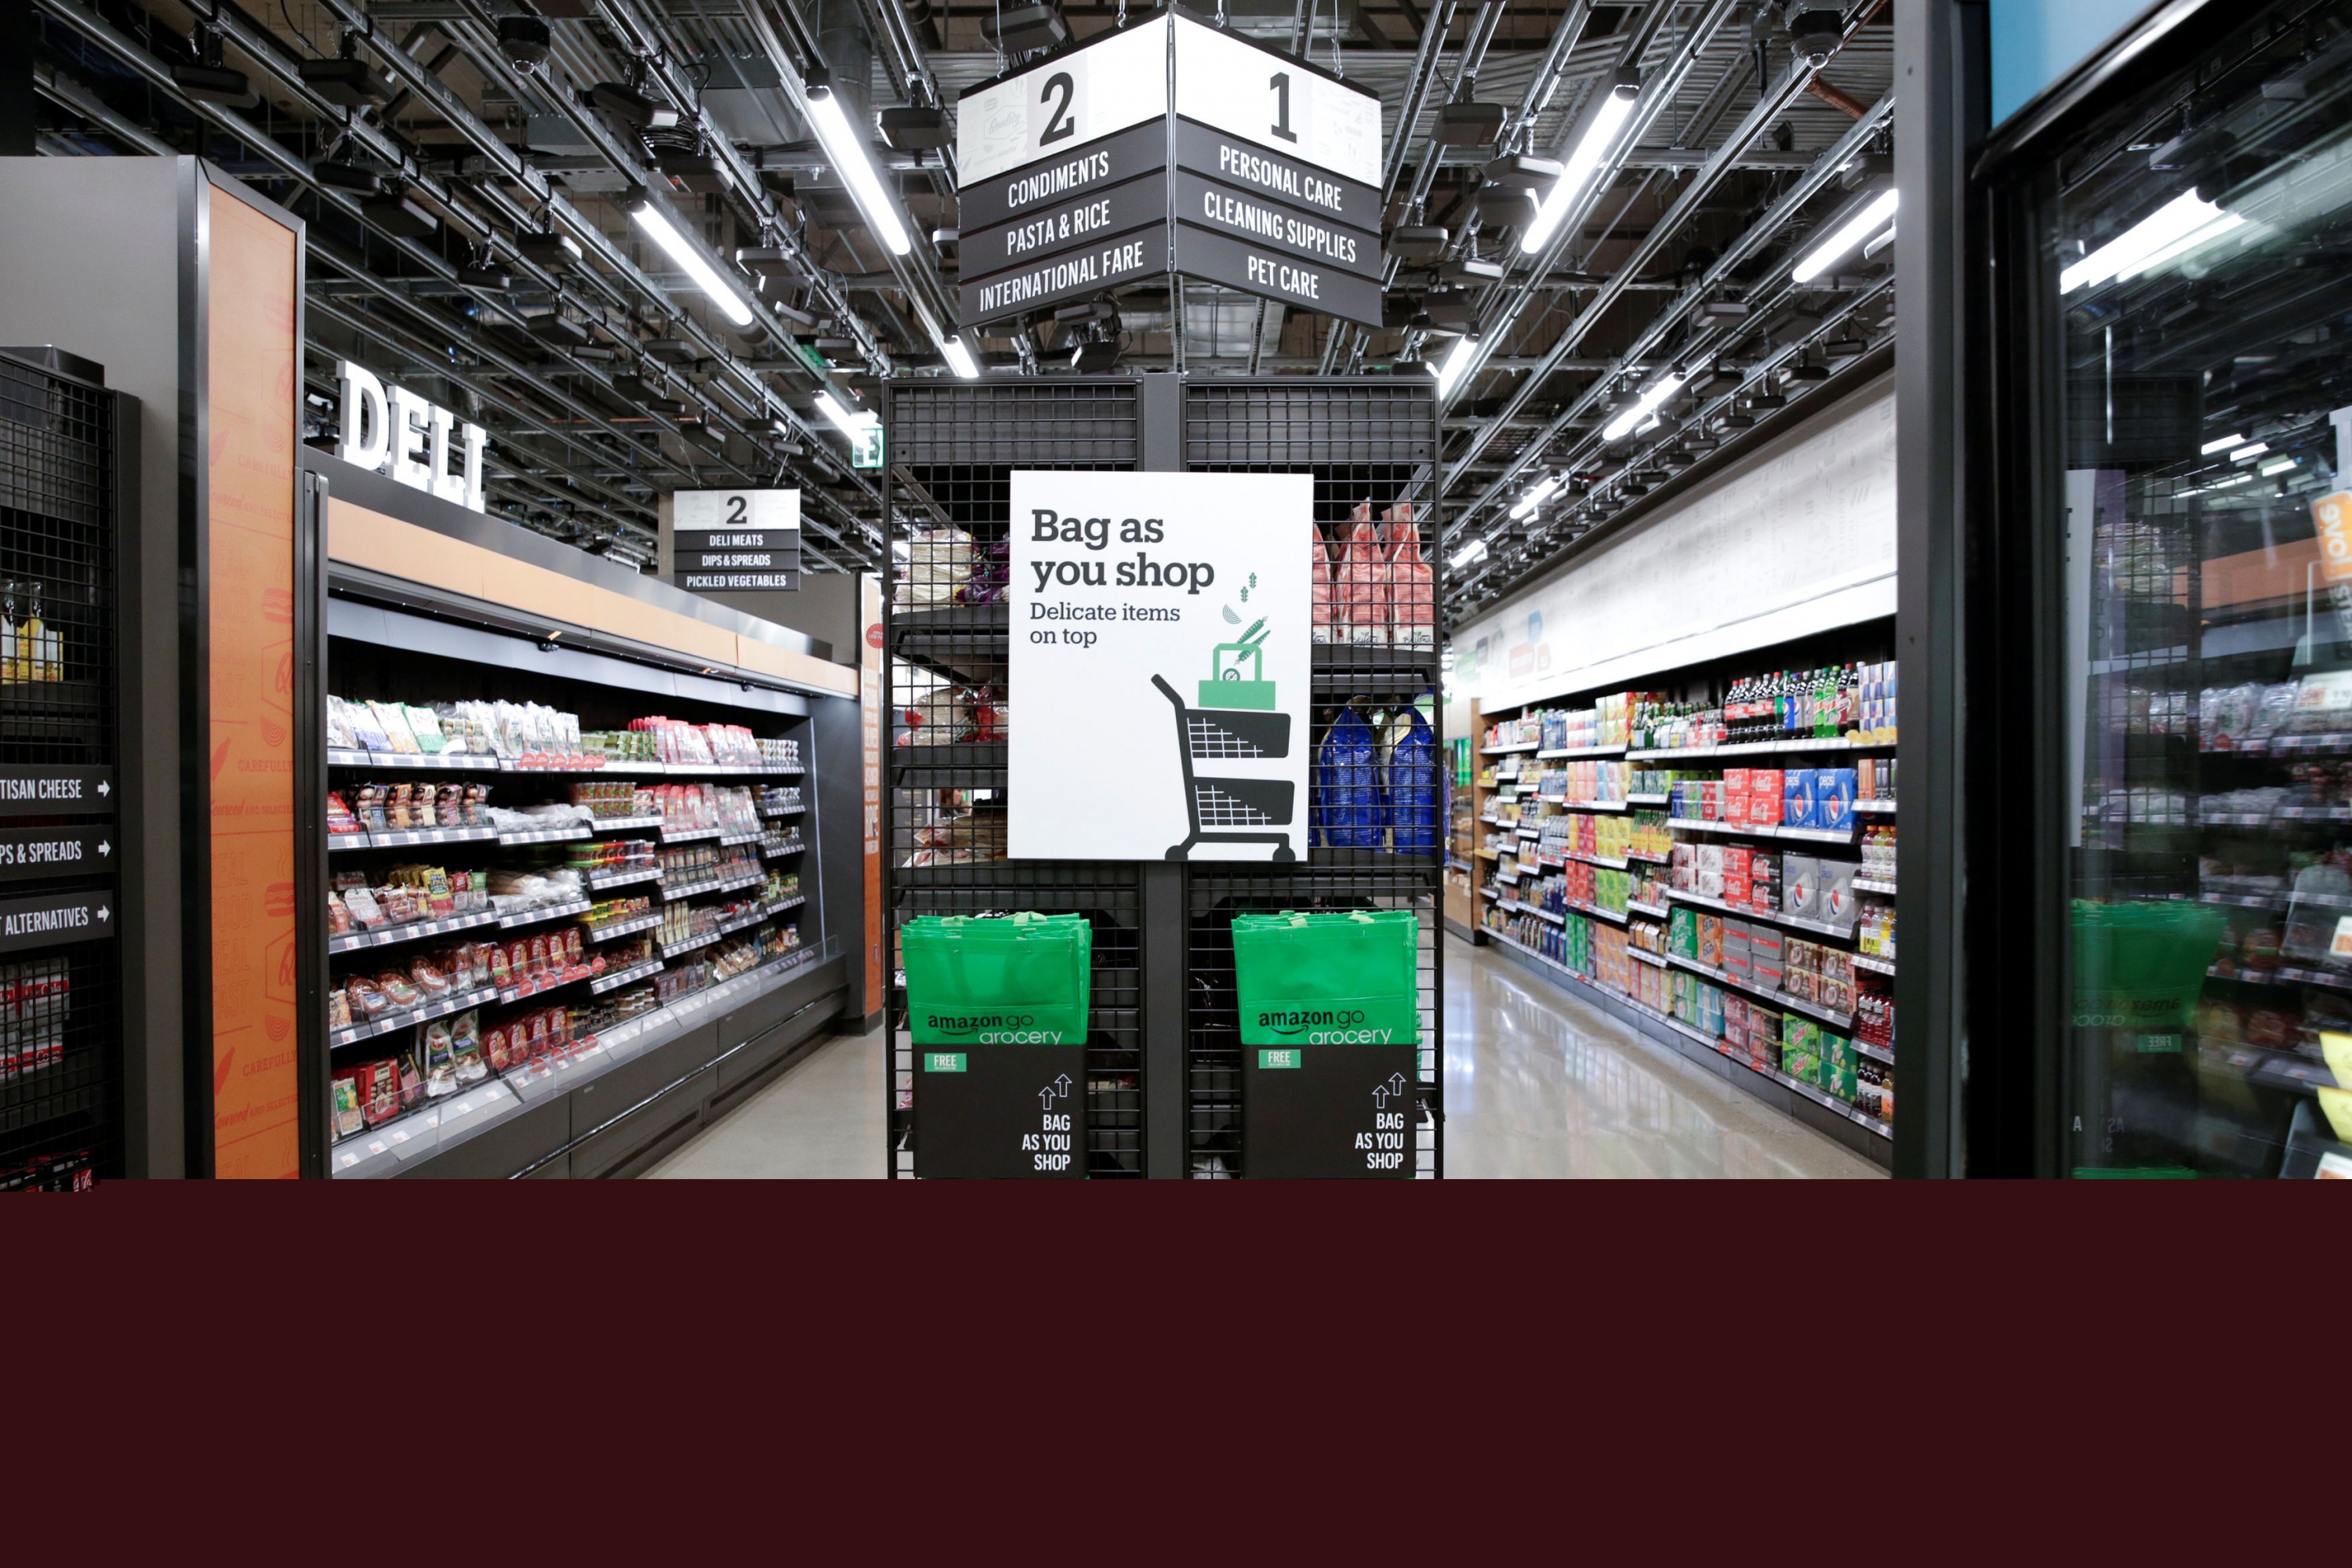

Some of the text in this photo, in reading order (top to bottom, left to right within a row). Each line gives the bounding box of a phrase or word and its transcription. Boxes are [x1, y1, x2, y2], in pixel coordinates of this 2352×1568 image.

[1039, 71, 1075, 147] 2
[1269, 71, 1298, 144] 1
[1007, 151, 1109, 208] CONDIMENTS
[1220, 145, 1341, 212] PERSONAL CARE
[1007, 199, 1111, 255] PASTA & RICE
[1204, 191, 1356, 263] CLEANING SUPPLIES
[979, 241, 1144, 312] INTERNATIONAL FARE
[1247, 256, 1319, 299] PET CARE
[336, 360, 487, 513] DELI
[726, 495, 747, 524] 2
[1031, 509, 1164, 551] Bag as
[710, 535, 764, 546] DELI MEATS
[702, 554, 771, 567] DIPS & SPREADS
[687, 575, 786, 587] PICKLED VEGETABLES
[1030, 552, 1214, 594] you shop
[1030, 602, 1181, 622] Delicate items
[1030, 628, 1098, 648] on top
[0, 779, 82, 800] TISAN CHEESE
[1785, 775, 1799, 789] pepsi
[1819, 773, 1835, 789] pepsi
[210, 798, 245, 817] ourced
[261, 804, 292, 815] SELECTE
[16, 844, 27, 863] &
[29, 840, 82, 862] SPREADS
[5, 906, 89, 936] ALTERNATIVES
[927, 1014, 1034, 1031] amazon go
[1258, 1010, 1365, 1029] amazon go
[979, 1030, 1062, 1045] grocery
[1309, 1028, 1392, 1044] grocery
[934, 1055, 956, 1066] FREE
[1268, 1051, 1290, 1063] FREE
[267, 1093, 298, 1112] SELECTE
[1043, 1114, 1070, 1131] BAG
[1376, 1113, 1403, 1130] BAG
[1022, 1134, 1070, 1151] AS YOU
[1355, 1133, 1403, 1149] AS YOU
[1034, 1154, 1070, 1171] SHOP
[1367, 1152, 1403, 1169] SHOP
